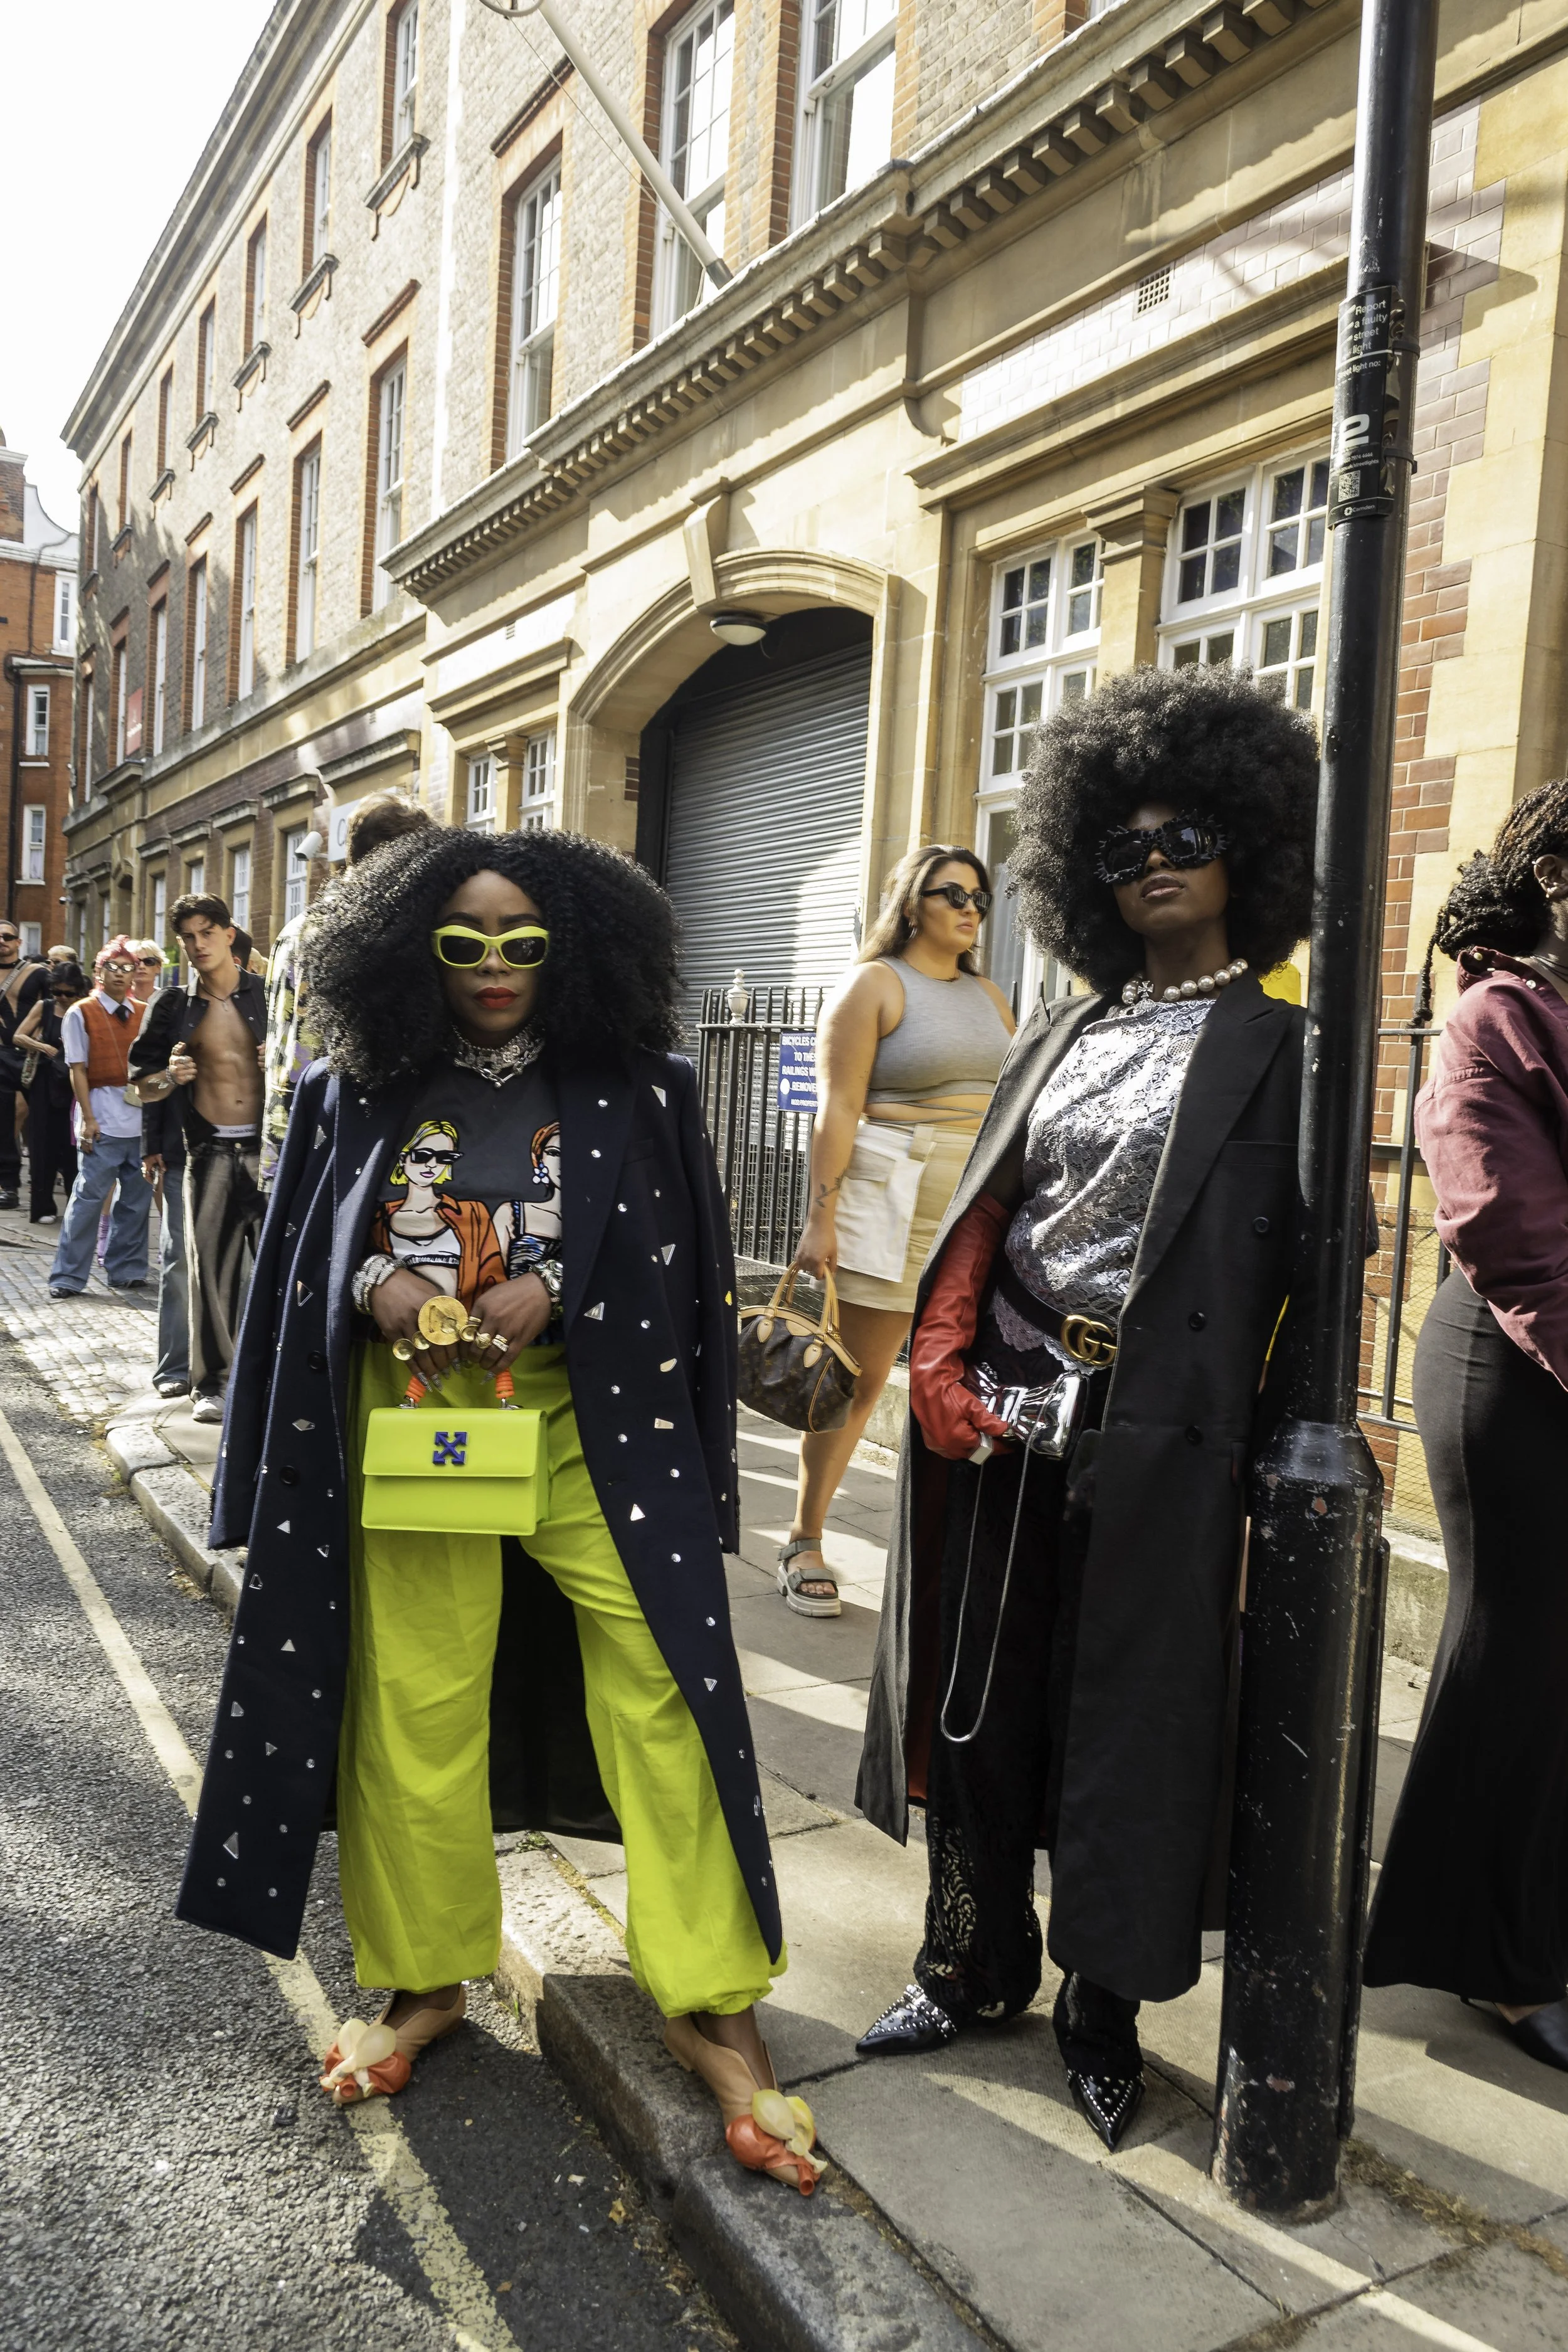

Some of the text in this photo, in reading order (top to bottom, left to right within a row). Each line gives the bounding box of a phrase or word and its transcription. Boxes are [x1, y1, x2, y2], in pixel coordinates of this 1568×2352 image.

[1355, 300, 1386, 315] Report
[1362, 314, 1387, 326] faulty
[1353, 327, 1379, 341] street
[1353, 341, 1372, 354] light
[1352, 363, 1367, 372] light
[782, 1036, 810, 1046] BICYCLES
[794, 1052, 803, 1061] TO
[782, 1066, 809, 1076] RAILINGS
